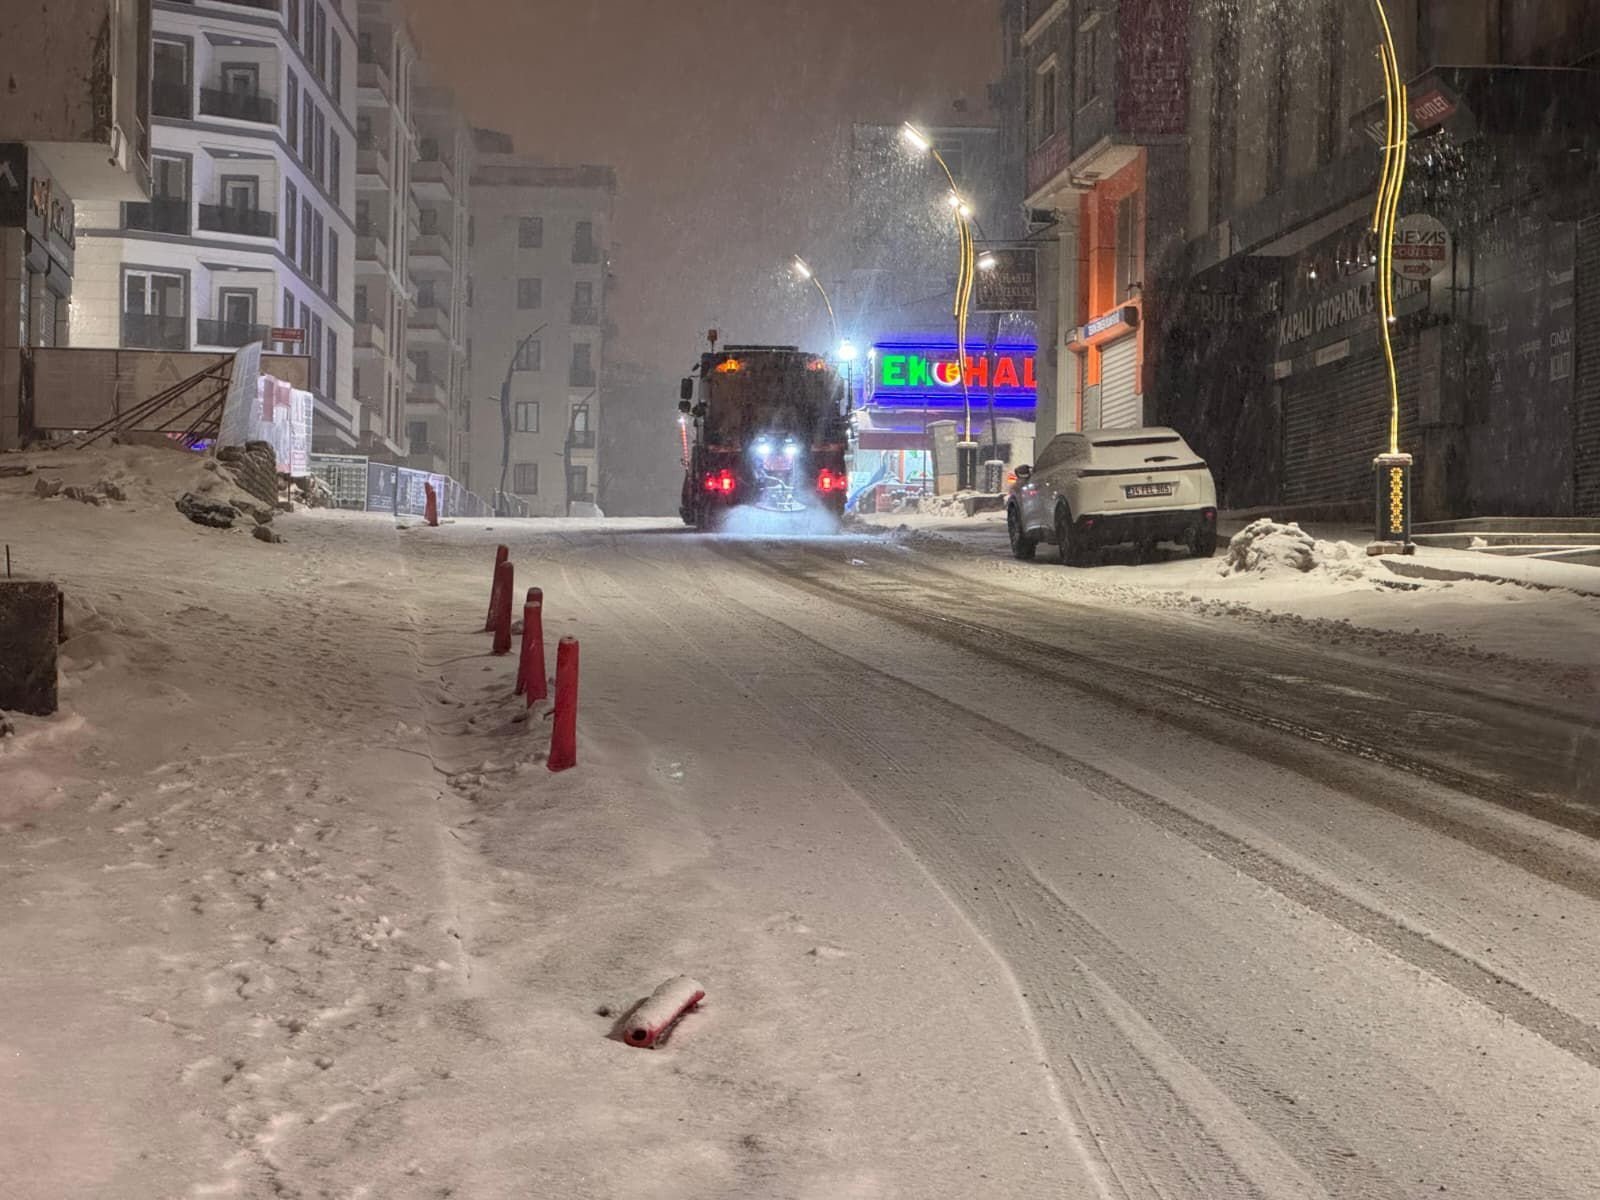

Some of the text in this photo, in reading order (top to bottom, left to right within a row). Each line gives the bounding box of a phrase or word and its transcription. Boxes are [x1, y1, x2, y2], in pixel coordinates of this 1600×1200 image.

[1416, 95, 1449, 120] OUTLET
[1395, 230, 1446, 244] NEVAS
[1400, 247, 1441, 257] OUTLET
[1315, 287, 1362, 332] OTOPARK
